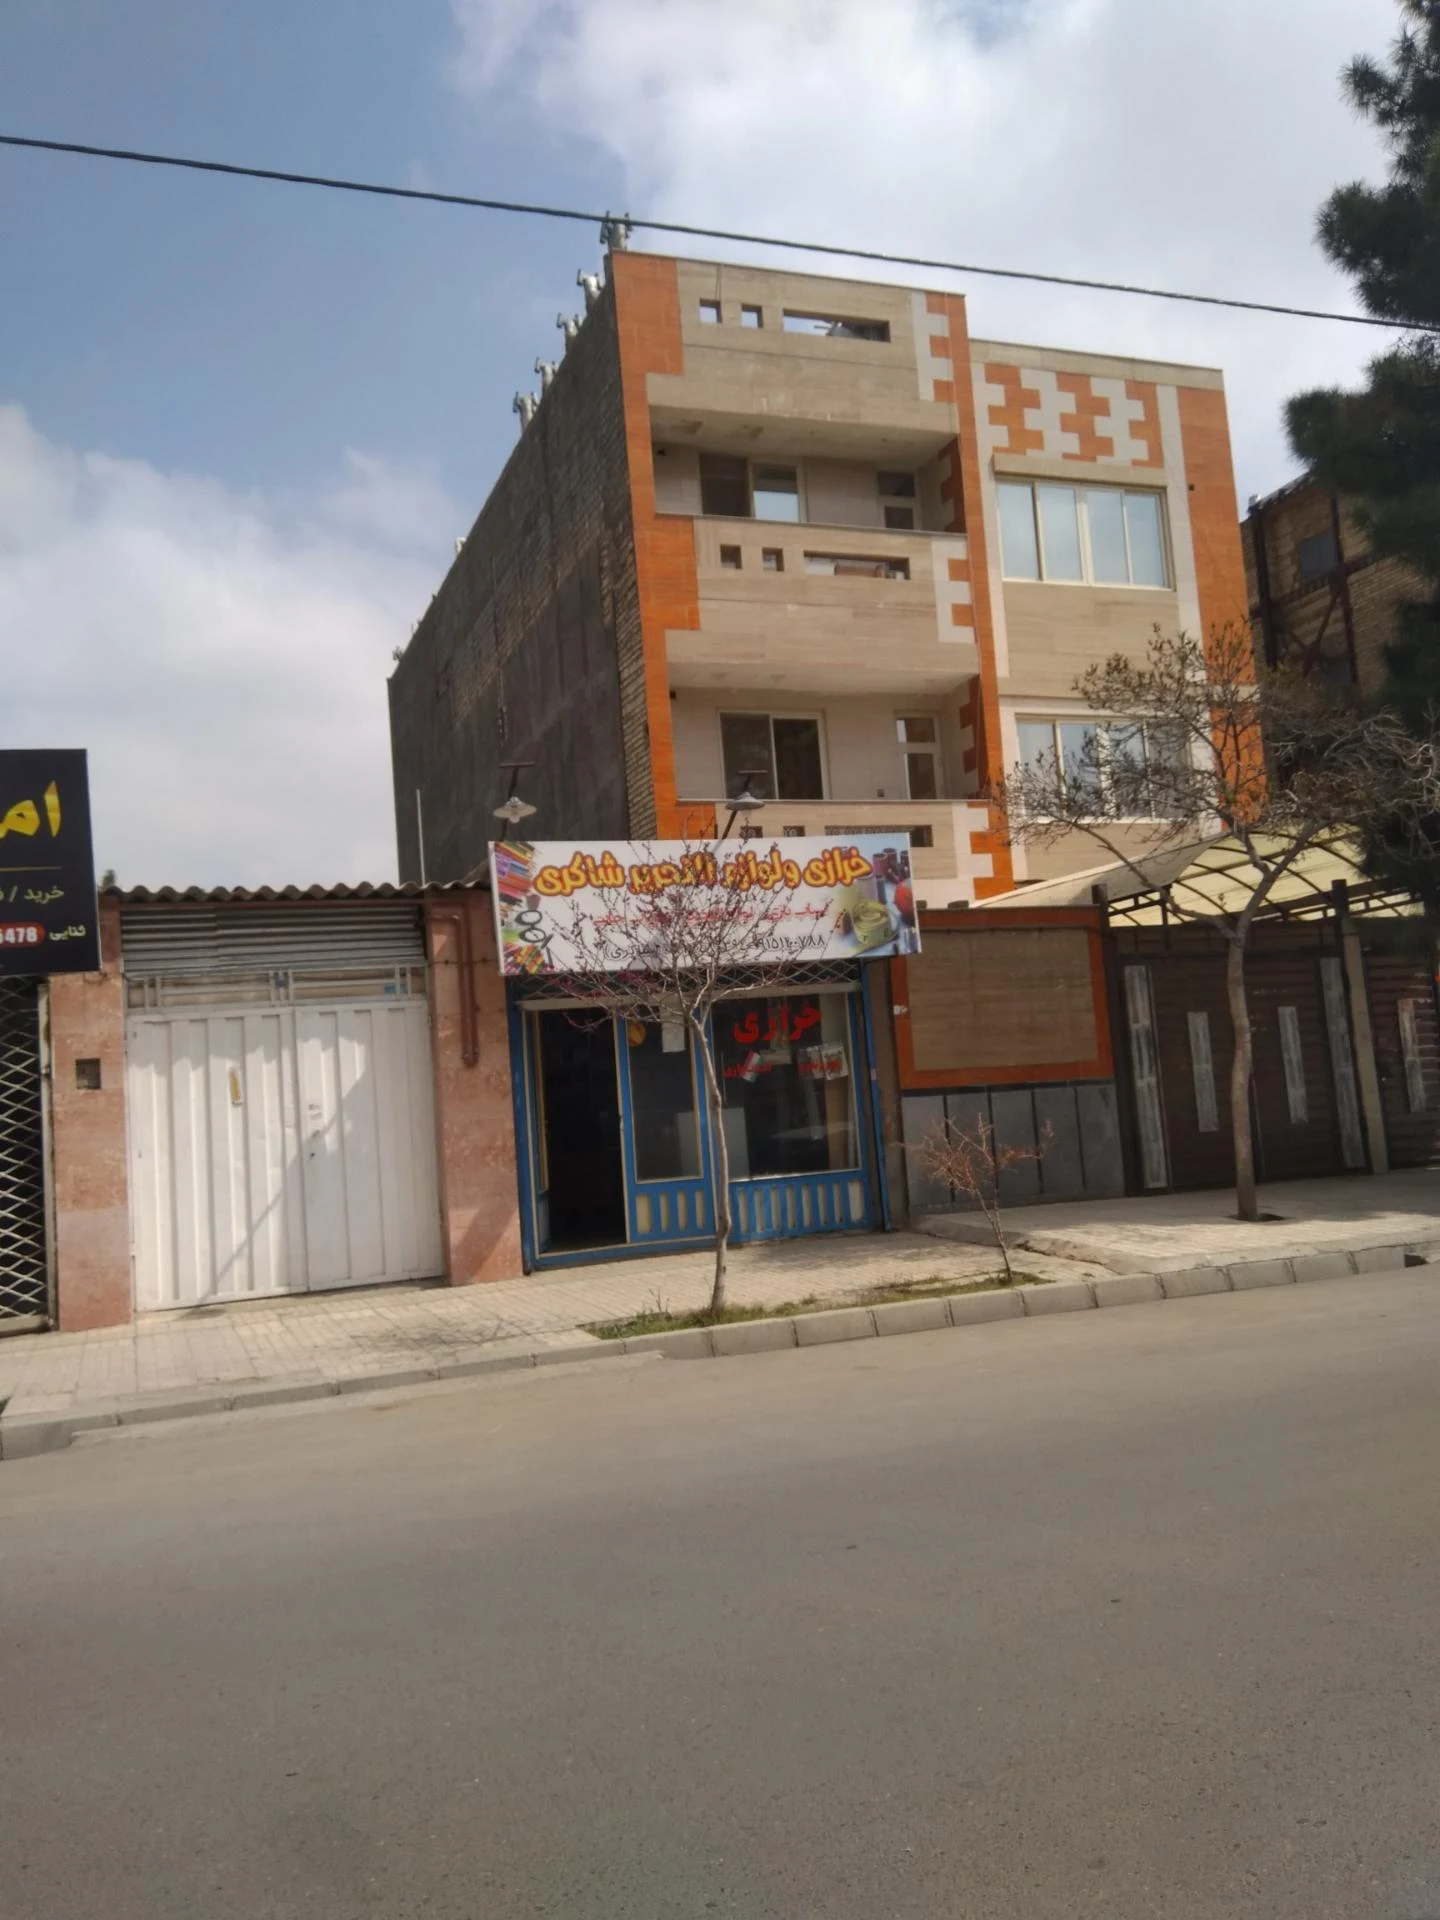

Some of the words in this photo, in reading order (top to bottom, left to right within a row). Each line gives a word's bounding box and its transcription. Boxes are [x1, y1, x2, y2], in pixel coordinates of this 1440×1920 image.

[0, 780, 61, 839] ام
[533, 850, 626, 897] شاکری
[802, 845, 873, 887] خرازی
[23, 885, 65, 905] خرید
[732, 999, 823, 1044] خرازی
